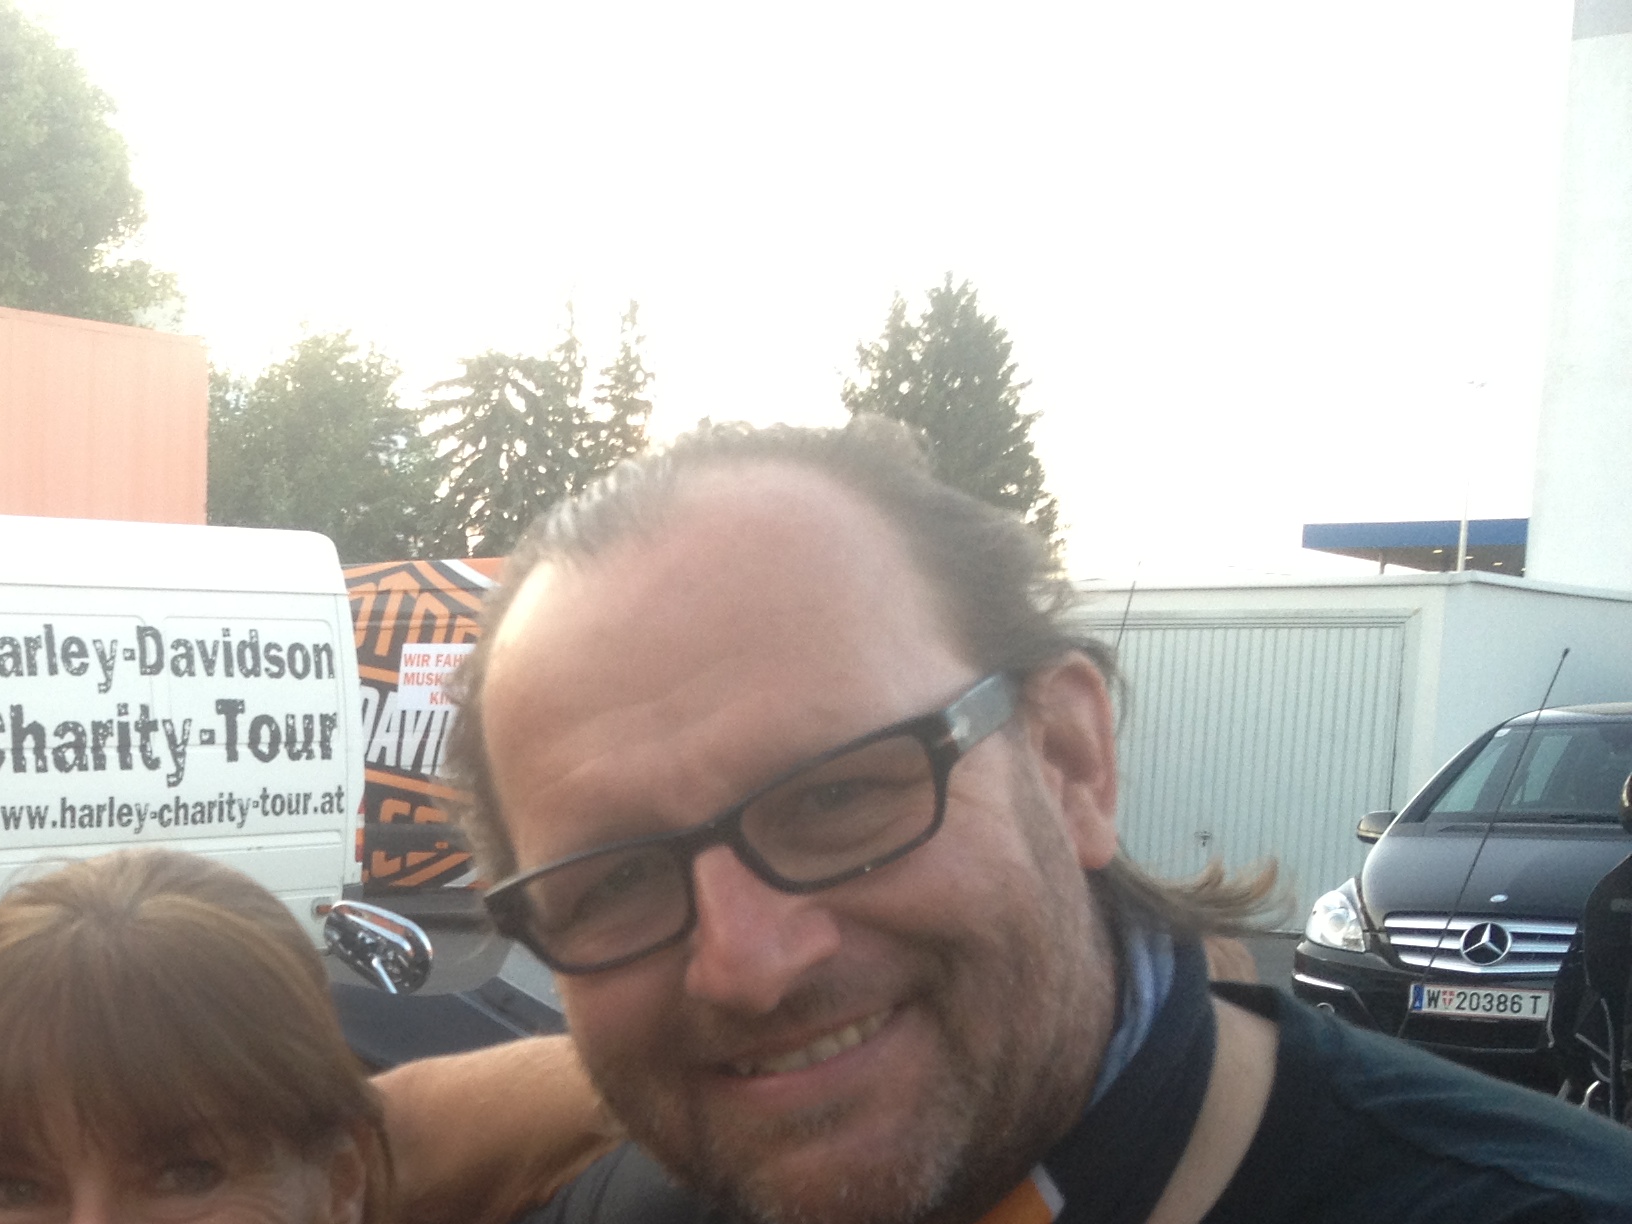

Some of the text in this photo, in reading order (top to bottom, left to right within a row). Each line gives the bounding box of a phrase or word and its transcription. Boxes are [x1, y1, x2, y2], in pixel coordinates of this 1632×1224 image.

[403, 653, 468, 668] WIR FAH
[403, 672, 444, 687] MUSK
[1426, 989, 1441, 1009] W
[1455, 990, 1524, 1014] 20386
[1530, 995, 1542, 1015] T
